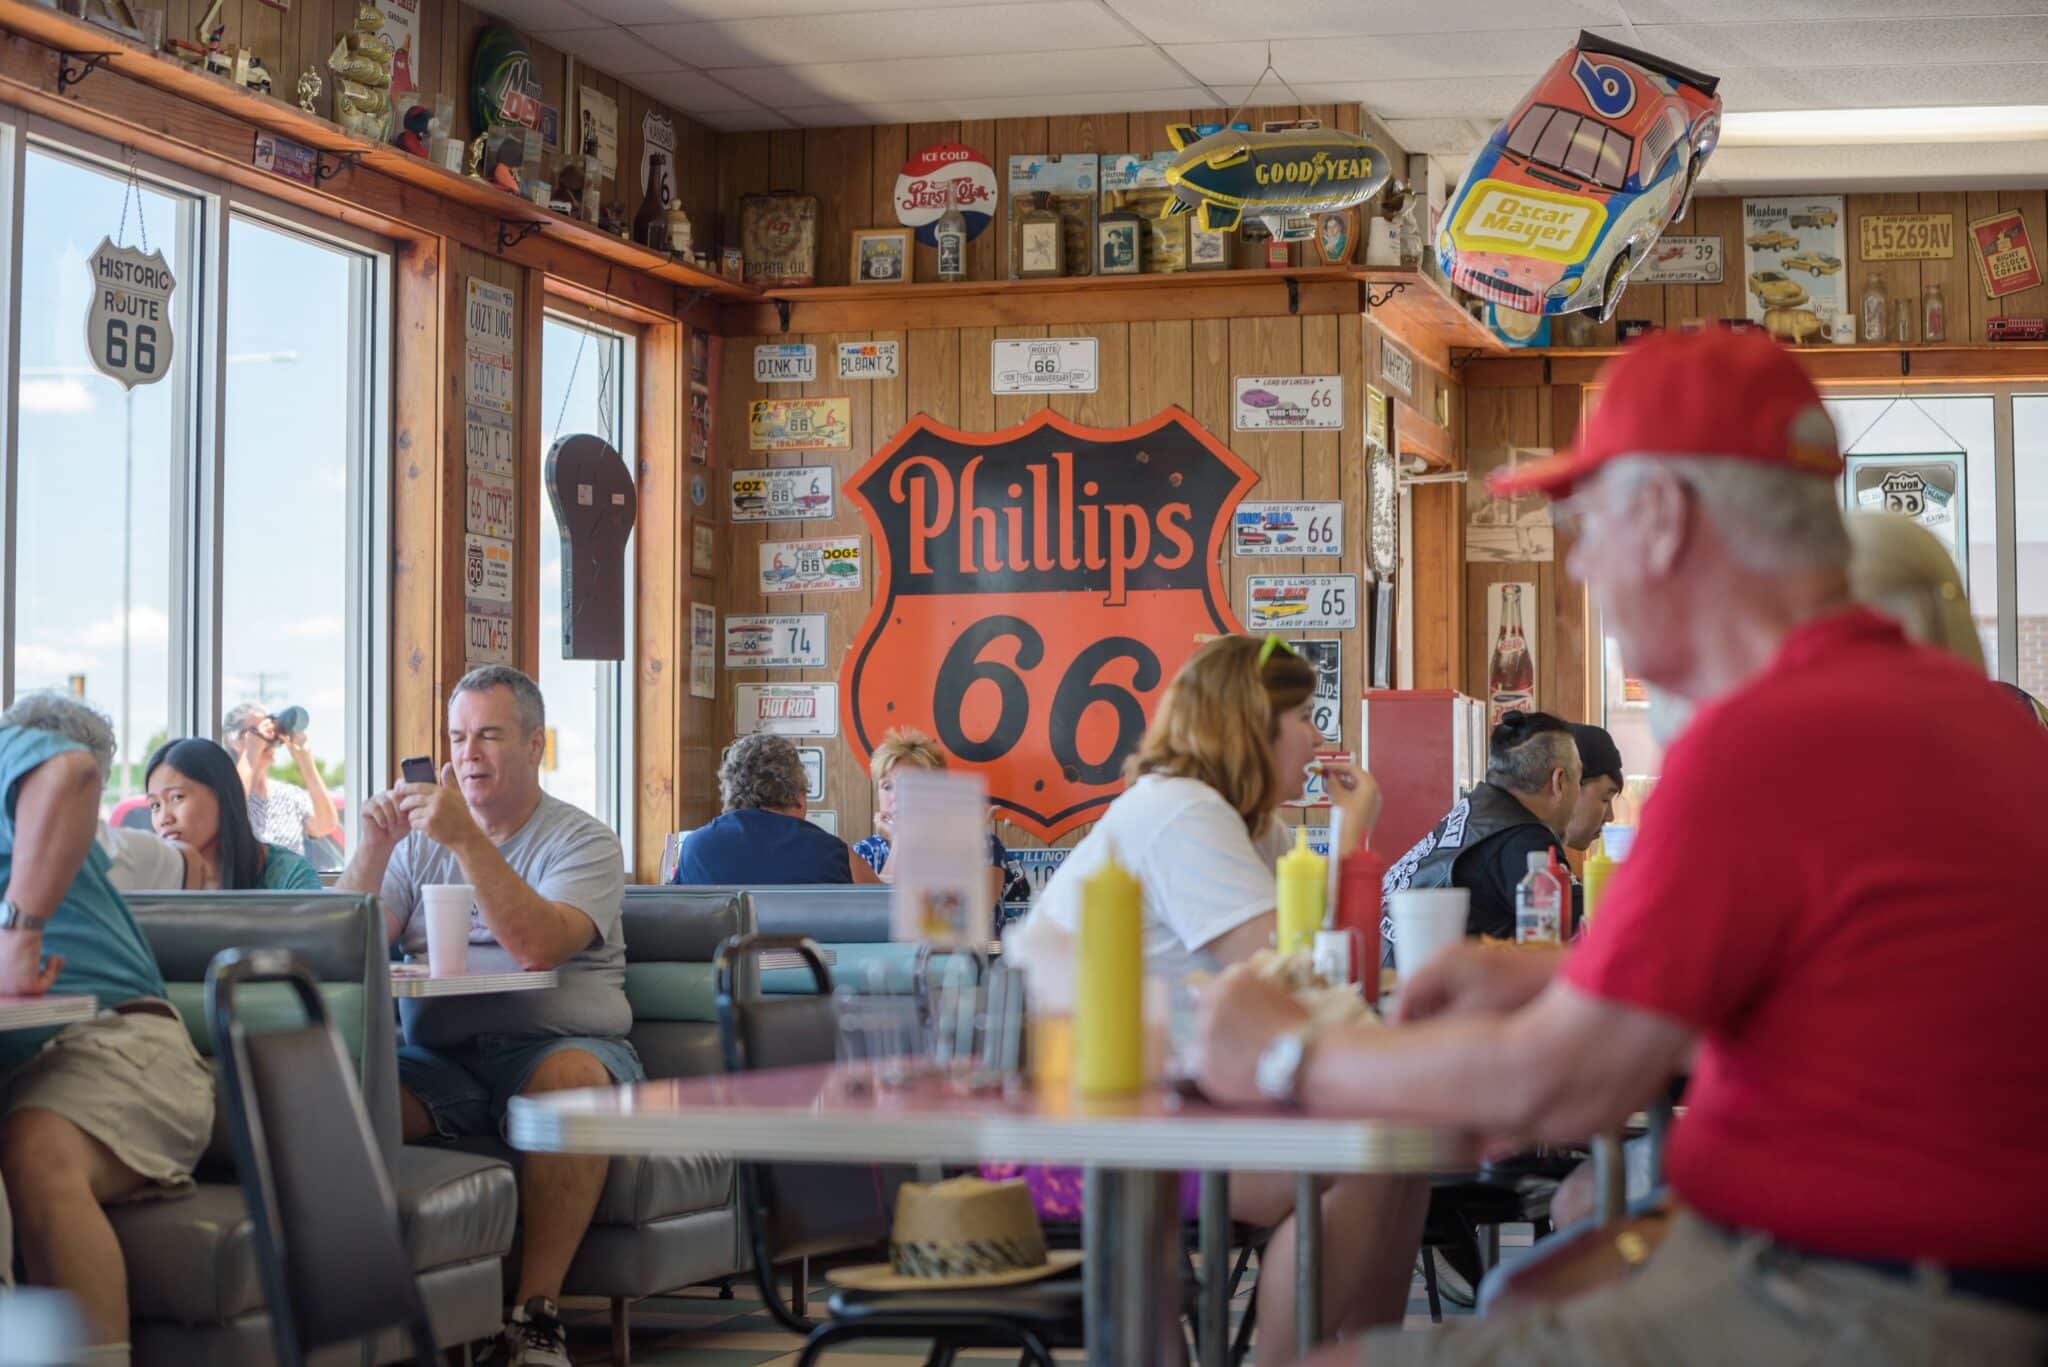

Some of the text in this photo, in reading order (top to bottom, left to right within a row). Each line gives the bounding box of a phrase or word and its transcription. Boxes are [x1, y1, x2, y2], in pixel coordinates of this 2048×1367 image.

[922, 151, 969, 162] ICE COLD
[1495, 198, 1574, 227] Oscar
[1746, 203, 1788, 218] Mustang
[1480, 211, 1572, 246] Mayer
[1871, 223, 1950, 250] 15269AV
[1695, 244, 1713, 260] 39
[99, 255, 169, 291] HISTORIC
[744, 261, 785, 276] MOTOR
[104, 290, 159, 322] ROUTE
[470, 300, 512, 340] COZY DOG
[106, 317, 157, 374] 66
[1031, 345, 1057, 354] ROUTE
[1034, 359, 1056, 373] 66
[473, 361, 496, 393] COZY
[1033, 374, 1070, 382] ANNIVERSARY
[1289, 378, 1316, 386] LINCOLN
[1310, 388, 1332, 408] 66
[790, 419, 808, 431] 66
[826, 408, 836, 427] 6
[468, 423, 490, 457] COZY
[809, 476, 820, 495] 6
[771, 490, 789, 502] 66
[889, 452, 1195, 606] Phillips
[1308, 516, 1333, 543] 66
[773, 551, 783, 571] 6
[823, 547, 858, 560] DOGS
[469, 558, 484, 583] 66
[801, 559, 820, 572] 66
[1321, 588, 1345, 616] 65
[471, 616, 492, 650] COZY
[787, 627, 811, 654] 74
[743, 640, 757, 650] 66
[760, 698, 814, 718] HOT ROD
[933, 615, 1162, 785] 66
[1023, 851, 1069, 862] ILLINO
